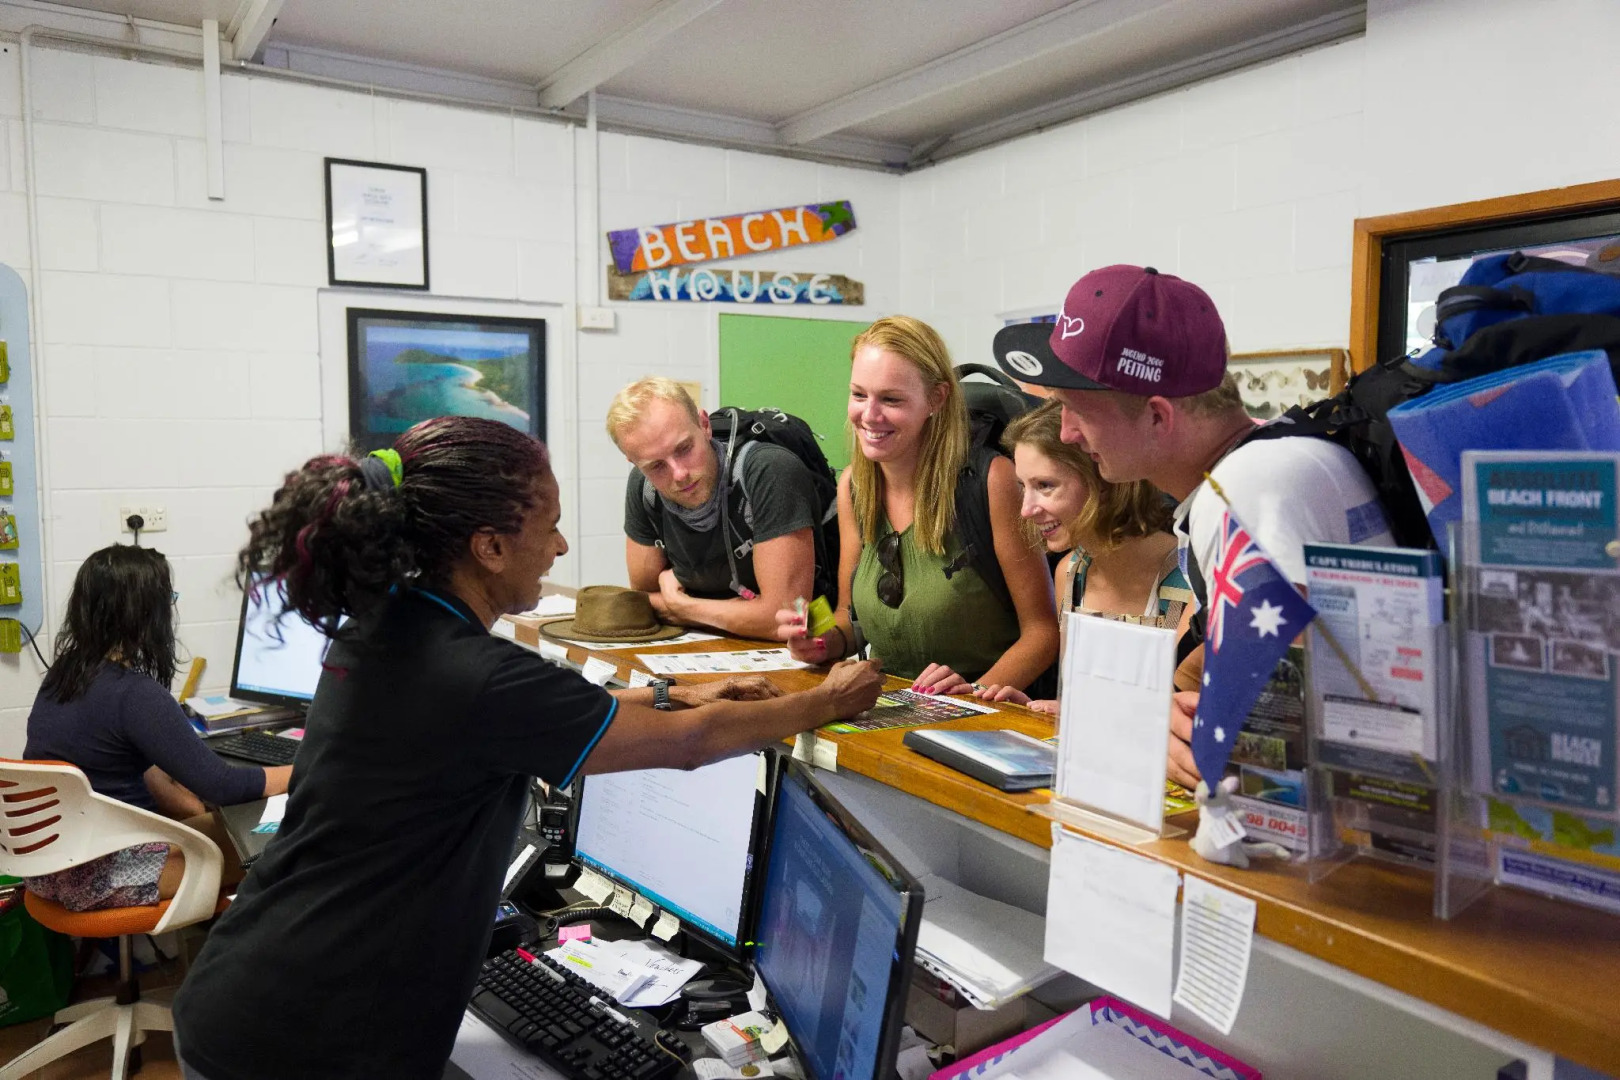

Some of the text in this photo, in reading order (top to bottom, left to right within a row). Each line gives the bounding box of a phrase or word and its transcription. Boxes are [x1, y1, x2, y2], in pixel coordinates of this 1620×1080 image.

[638, 206, 810, 268] BEACH
[648, 267, 832, 304] HOUSE
[1116, 357, 1162, 382] PEITING
[1487, 489, 1604, 509] BEACH FRONT
